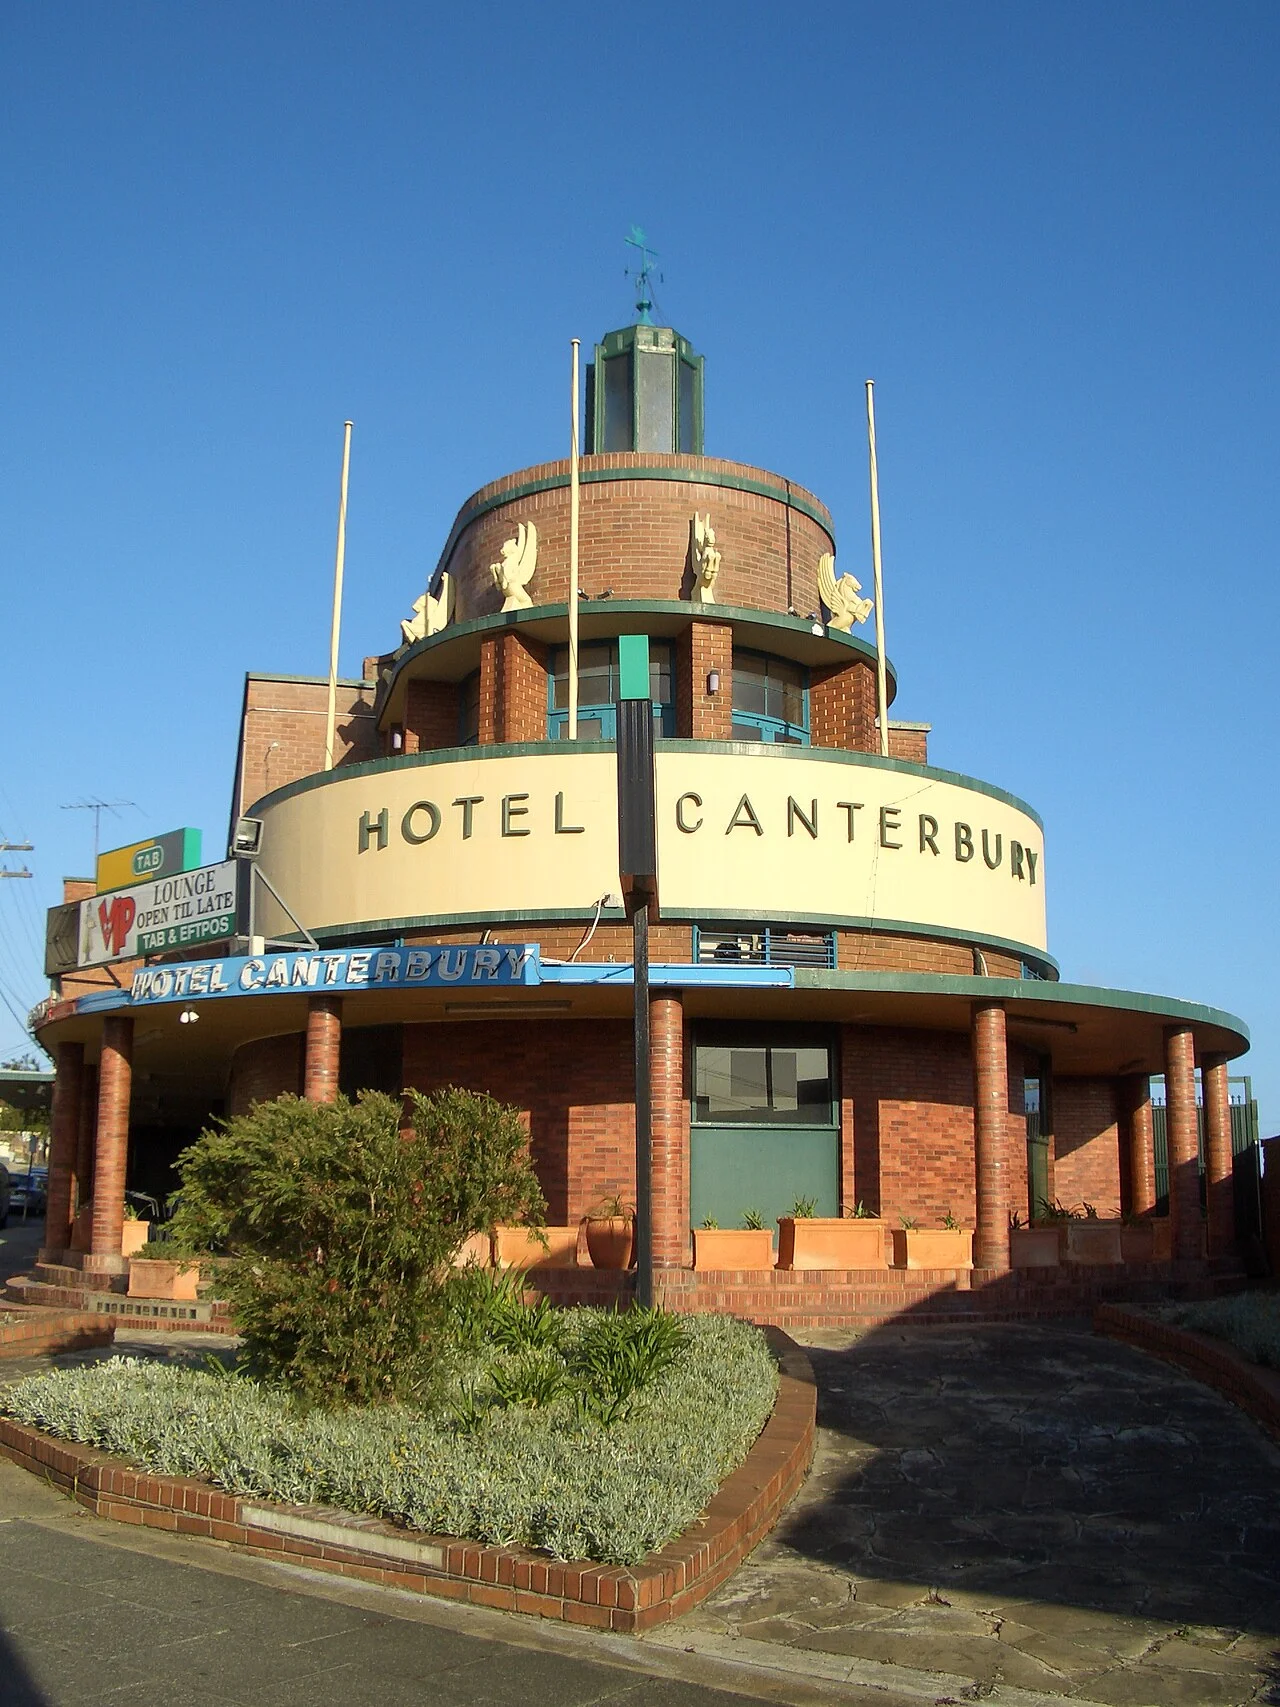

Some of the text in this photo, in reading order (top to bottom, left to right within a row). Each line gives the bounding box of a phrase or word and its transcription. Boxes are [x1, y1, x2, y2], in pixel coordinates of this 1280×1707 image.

[358, 790, 1038, 887] HOTEL CANTERBURY
[137, 852, 159, 870] TAB
[153, 870, 216, 906] LOUNGE
[137, 891, 233, 929] OPEN TIL LATE
[143, 916, 230, 949] TAB & EFTPOS
[131, 948, 535, 1000] HOTEL CANTERBURY
